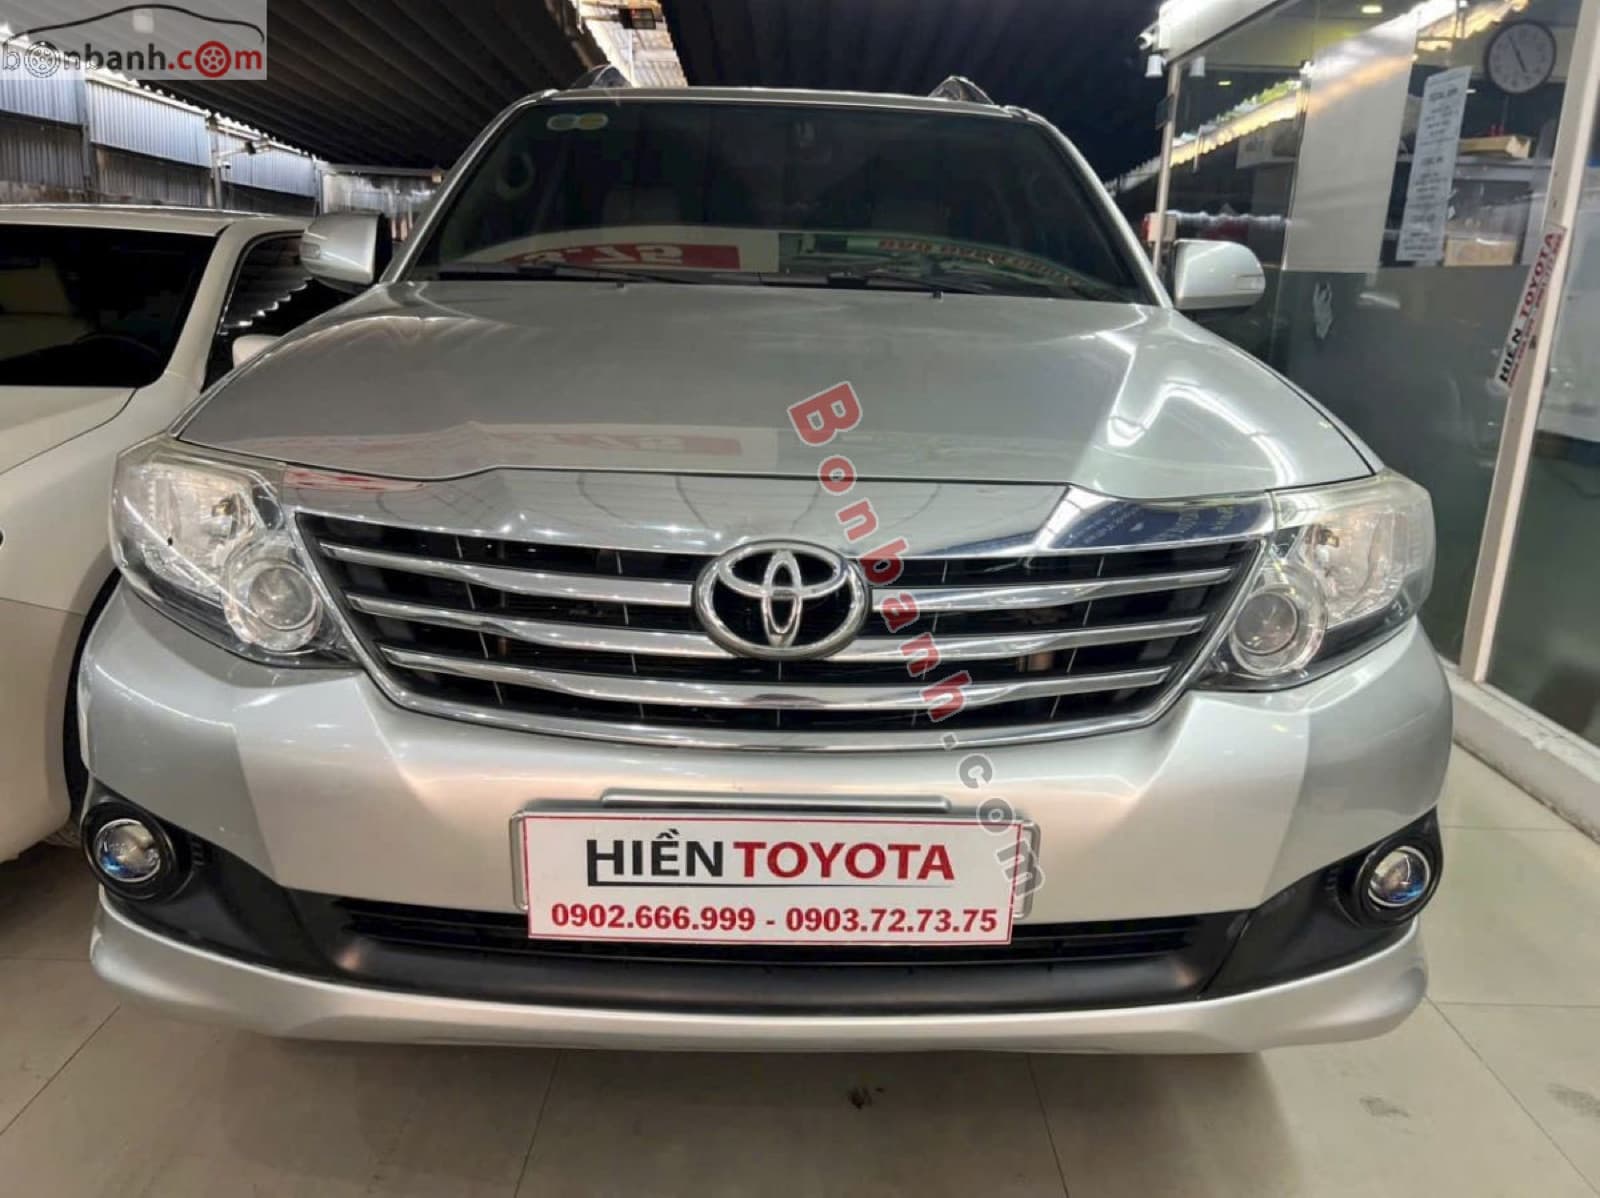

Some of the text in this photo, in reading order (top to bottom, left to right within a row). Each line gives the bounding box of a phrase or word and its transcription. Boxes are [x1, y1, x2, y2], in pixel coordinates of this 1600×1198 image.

[1519, 233, 1558, 318] TOYOTA
[586, 828, 955, 887] HIỀN TOYOTA
[551, 903, 756, 931] 0902.666.999
[785, 907, 998, 932] 0903.72.73.75
